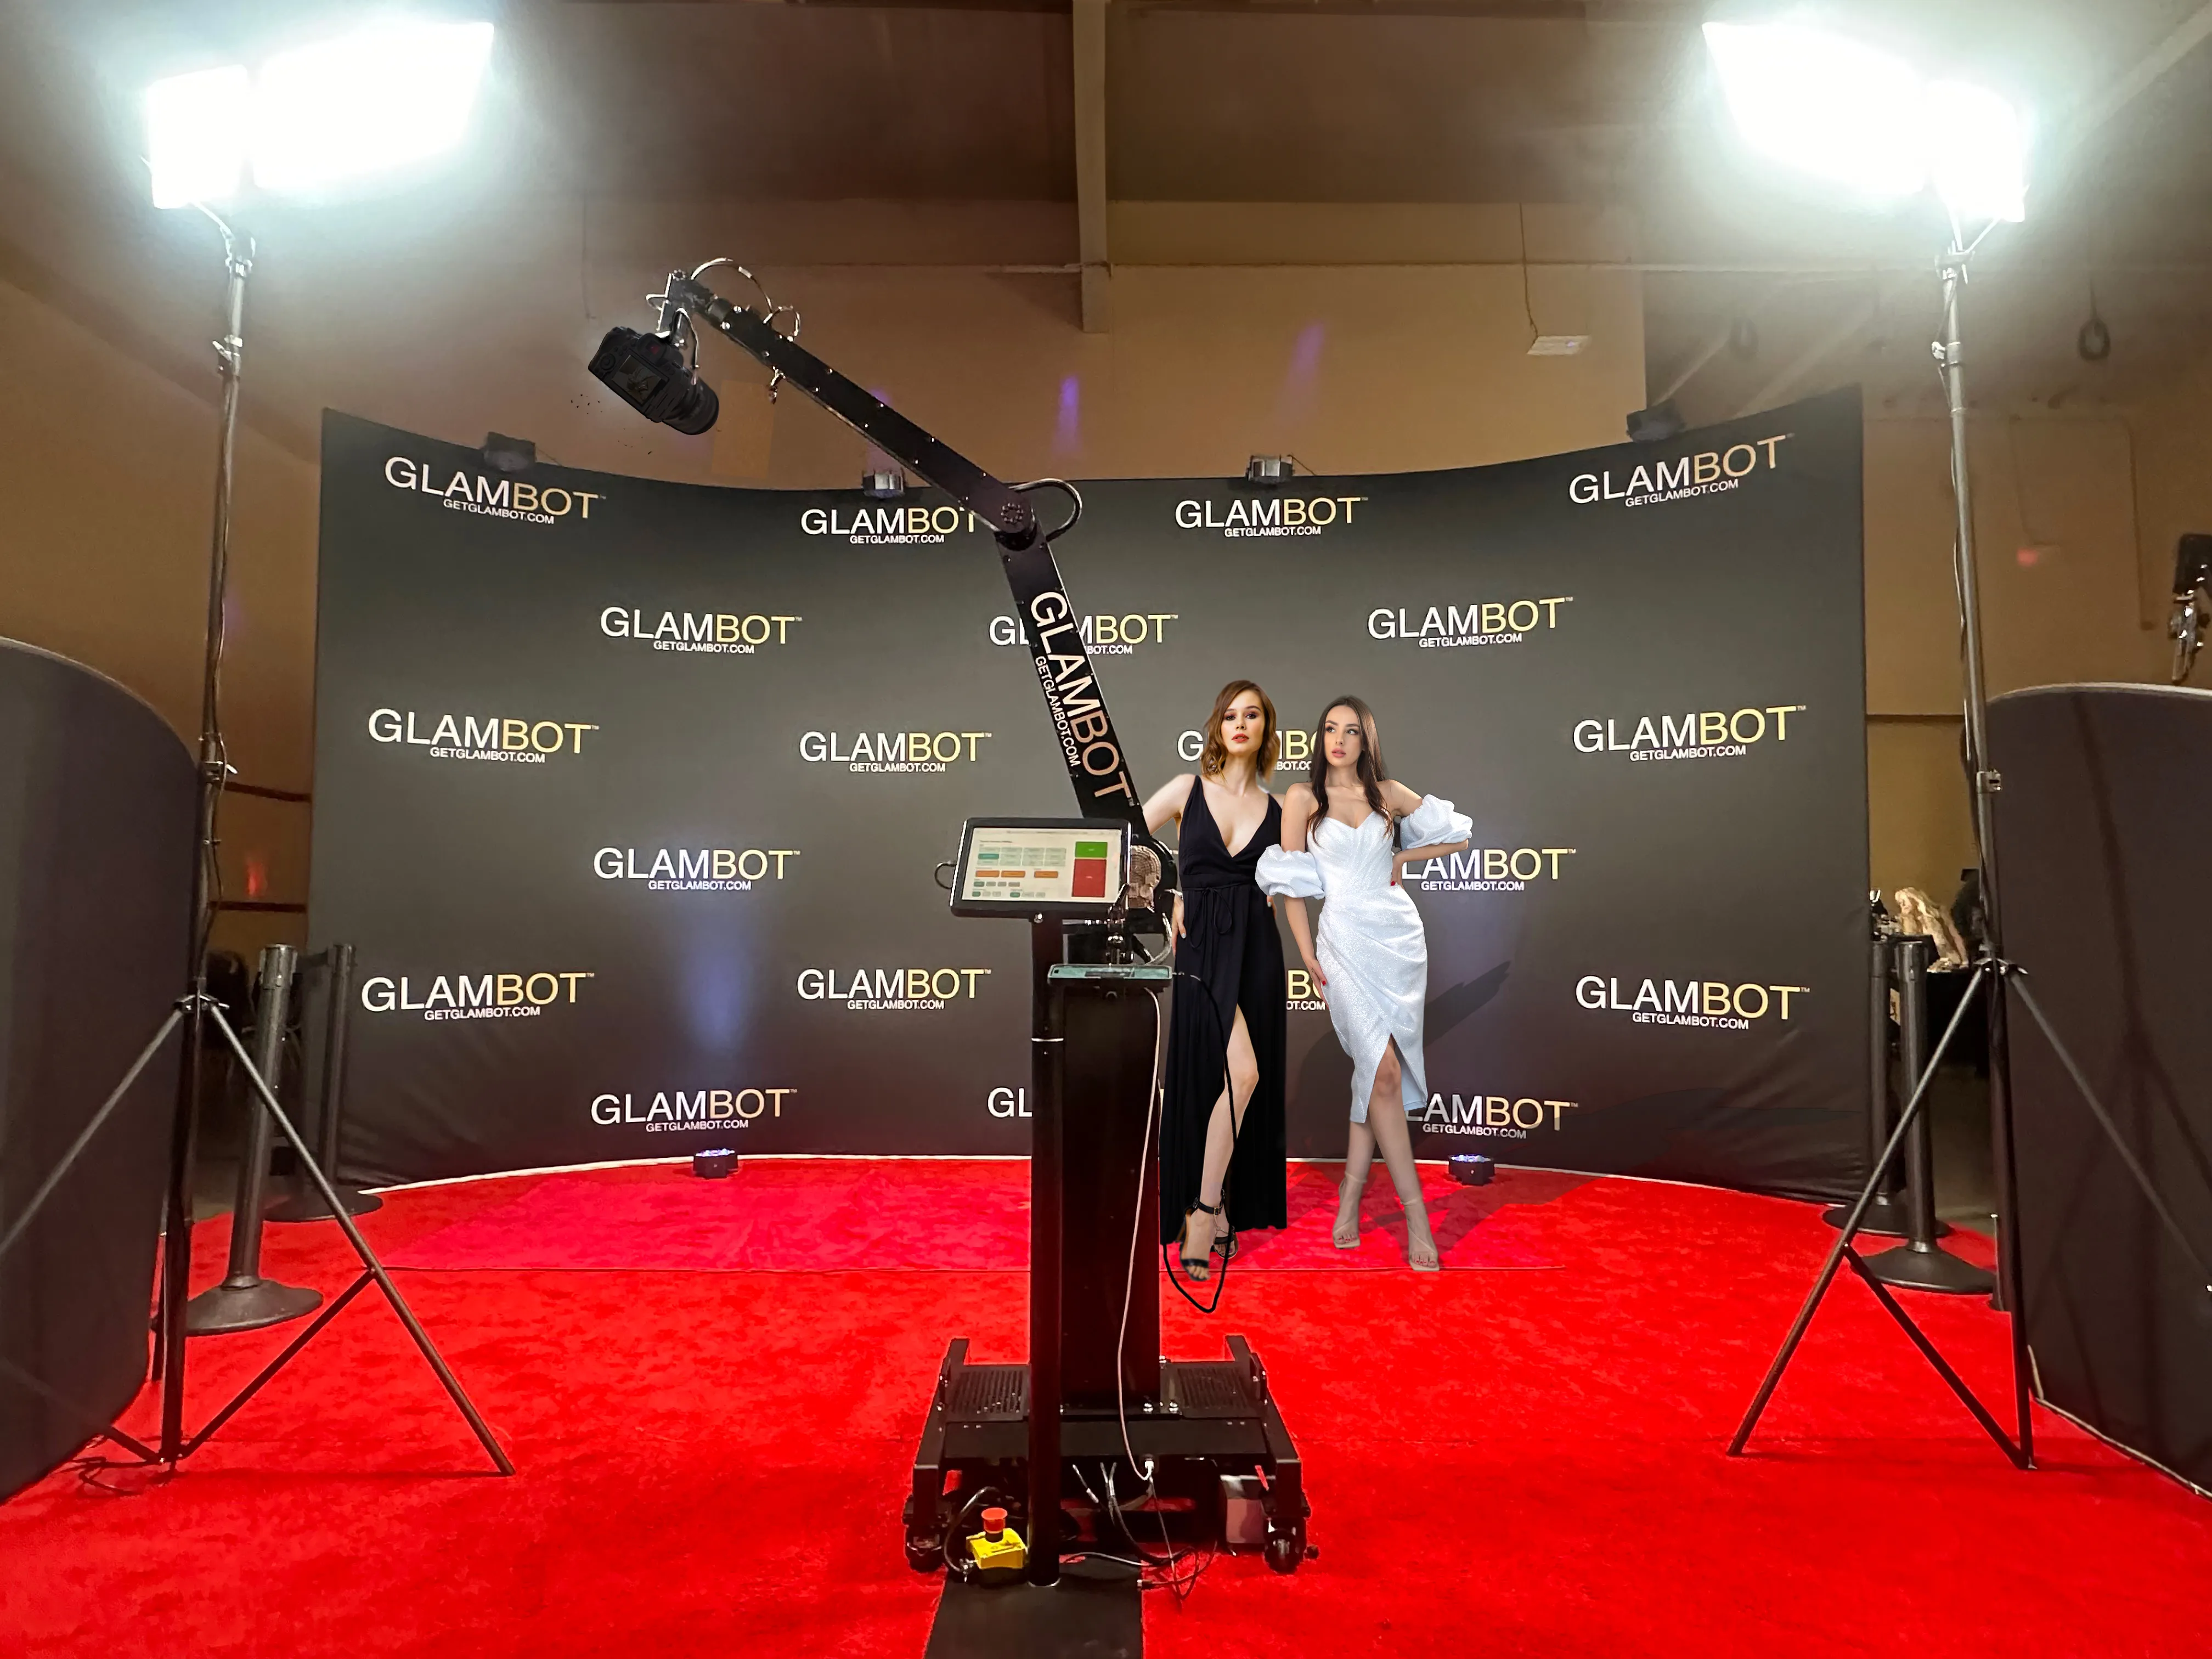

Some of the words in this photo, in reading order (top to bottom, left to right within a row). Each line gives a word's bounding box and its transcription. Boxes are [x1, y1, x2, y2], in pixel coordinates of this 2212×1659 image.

[1626, 479, 1739, 507] GETGLAMBOT.COM
[443, 499, 555, 524] GETGLAMBOT.COM
[849, 534, 945, 544] GETGLAMBOT.COM
[1224, 526, 1321, 537] GETGLAMBOT.COM
[653, 640, 755, 654] GETGLAMBOT.COM
[1419, 632, 1522, 648] GETGLAMBOT.COM
[1035, 656, 1081, 768] GETGLAMBOT.COM
[430, 746, 545, 763] GETGLAMBOT.COM
[1629, 744, 1747, 761] GETGLAMBOT.COM
[849, 763, 946, 772] GETGLAMBOT.COM
[648, 880, 752, 891] GETGLAMBOT.COM
[1421, 881, 1525, 891] GETGLAMBOT.COM
[847, 998, 945, 1010] GETGLAMBOT.COM
[424, 1006, 541, 1021] GETGLAMBOT.COM
[1632, 1012, 1749, 1030] GETGLAMBOT.COM
[645, 1120, 749, 1132] GETGLAMBOT.COM
[1422, 1124, 1527, 1139] GETGLAMBOT.COM
